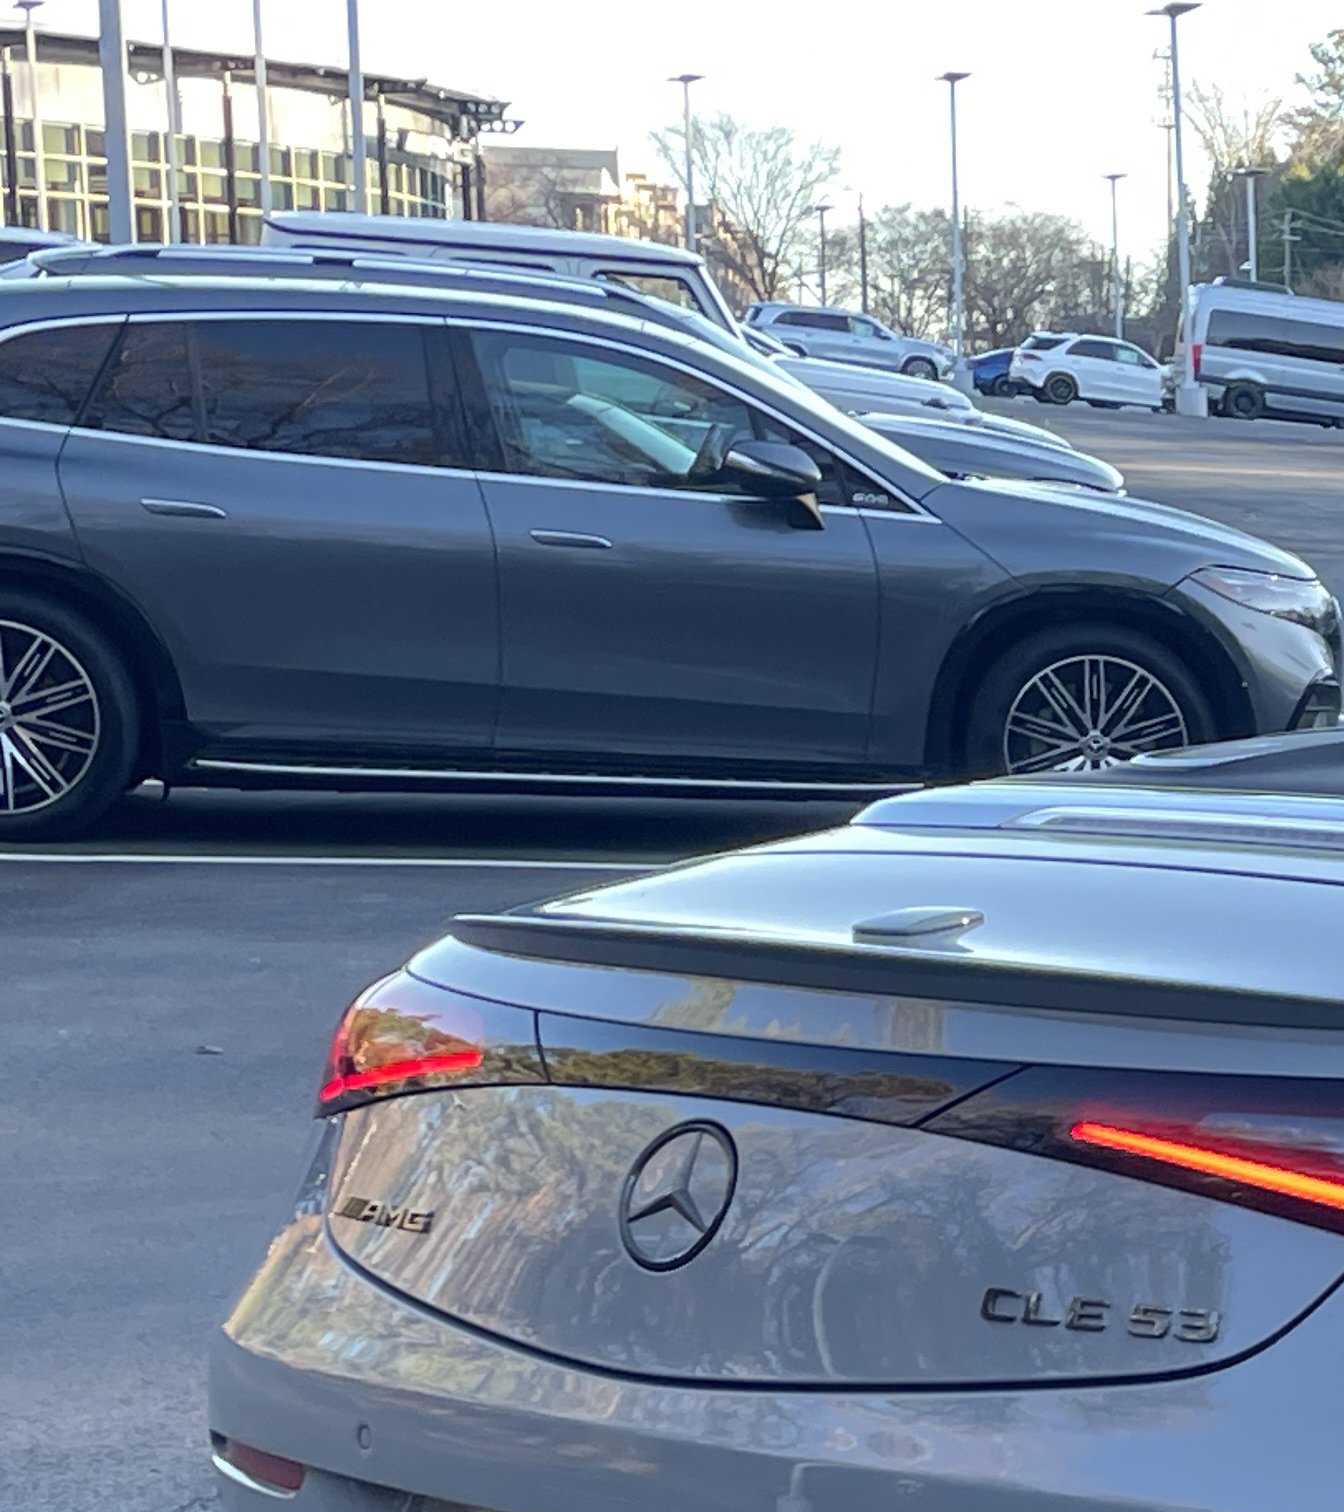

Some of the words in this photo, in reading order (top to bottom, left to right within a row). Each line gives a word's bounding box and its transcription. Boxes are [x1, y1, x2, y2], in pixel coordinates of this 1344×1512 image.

[354, 1198, 435, 1233] AMG
[980, 1287, 1111, 1332] CLE
[1127, 1303, 1223, 1343] 53
